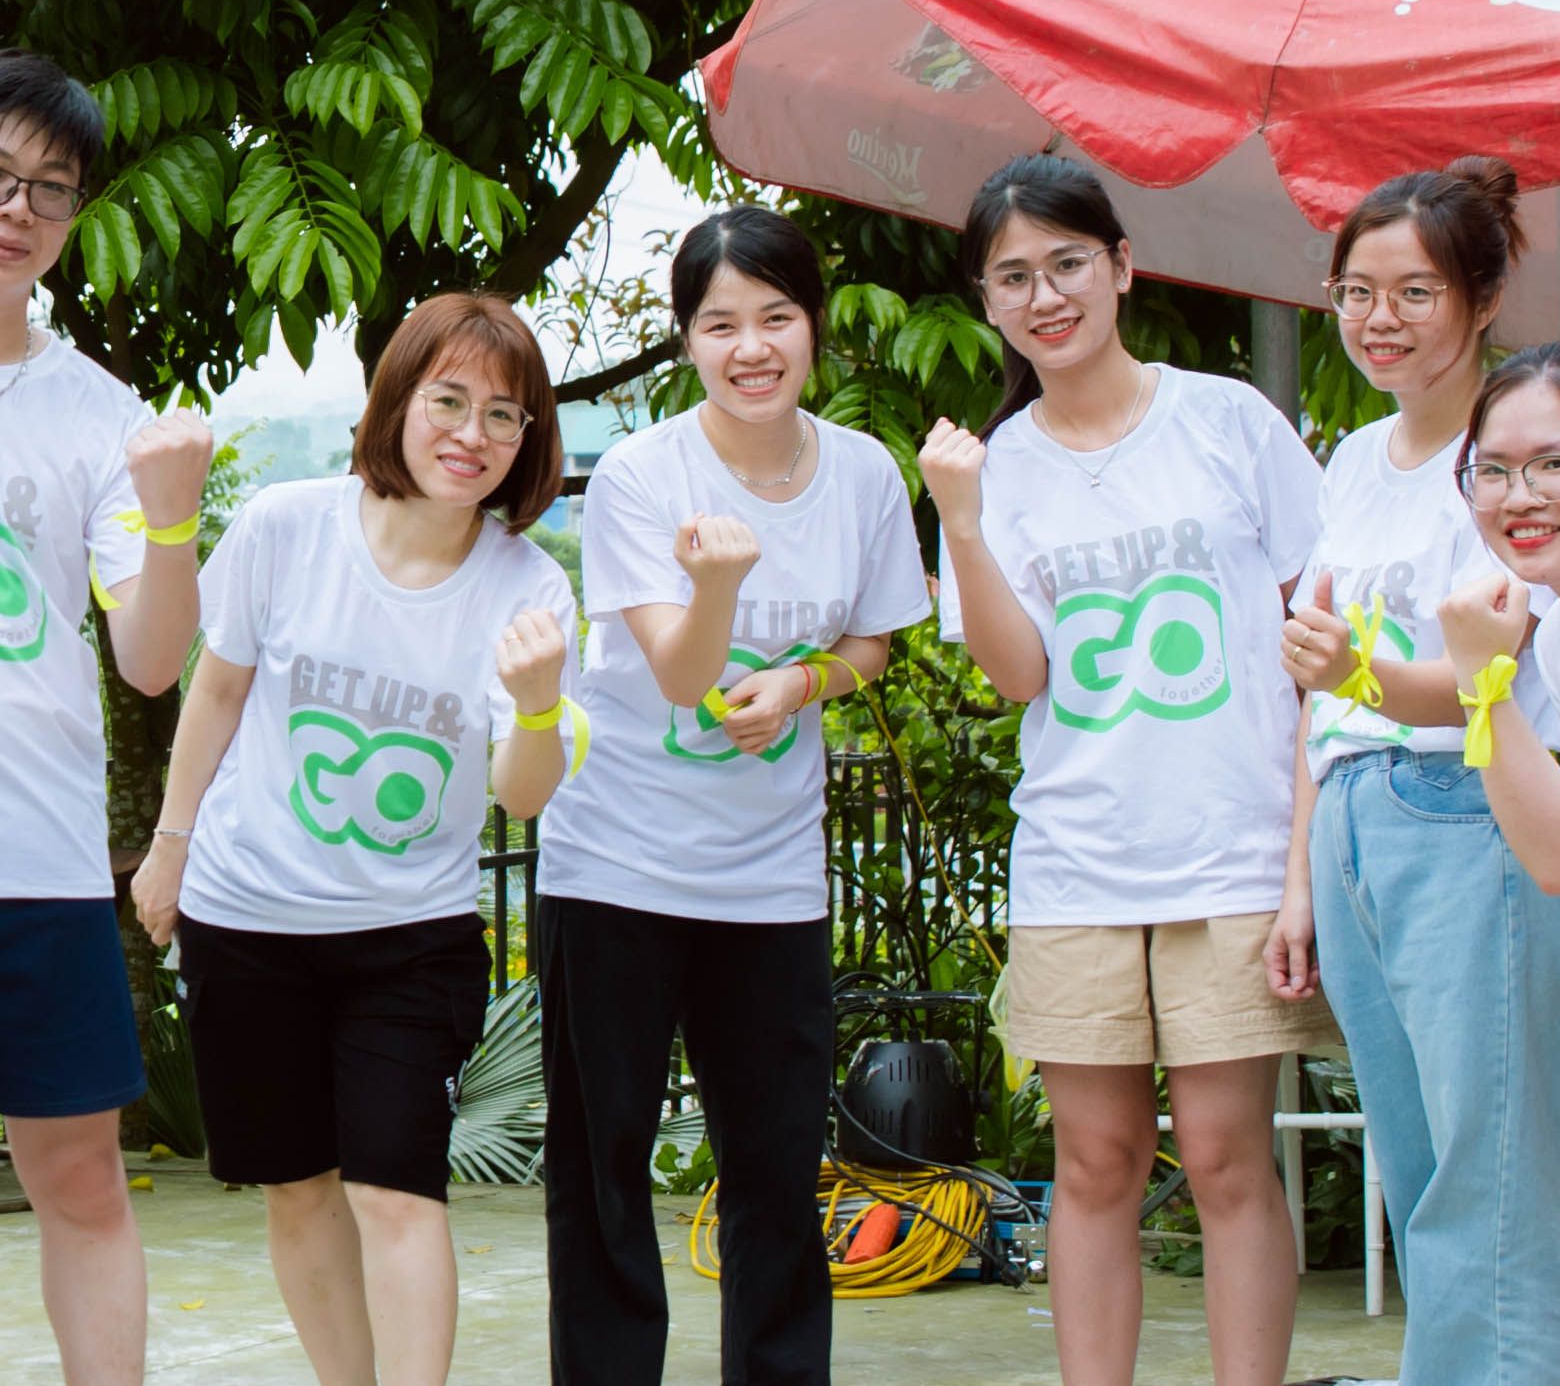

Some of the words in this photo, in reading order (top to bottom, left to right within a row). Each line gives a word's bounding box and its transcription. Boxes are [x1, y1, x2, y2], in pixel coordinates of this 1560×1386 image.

[1030, 540, 1102, 609] GET
[289, 654, 366, 713] GET
[1049, 573, 1232, 734] GO
[1159, 656, 1224, 701] together
[287, 709, 455, 856] GO
